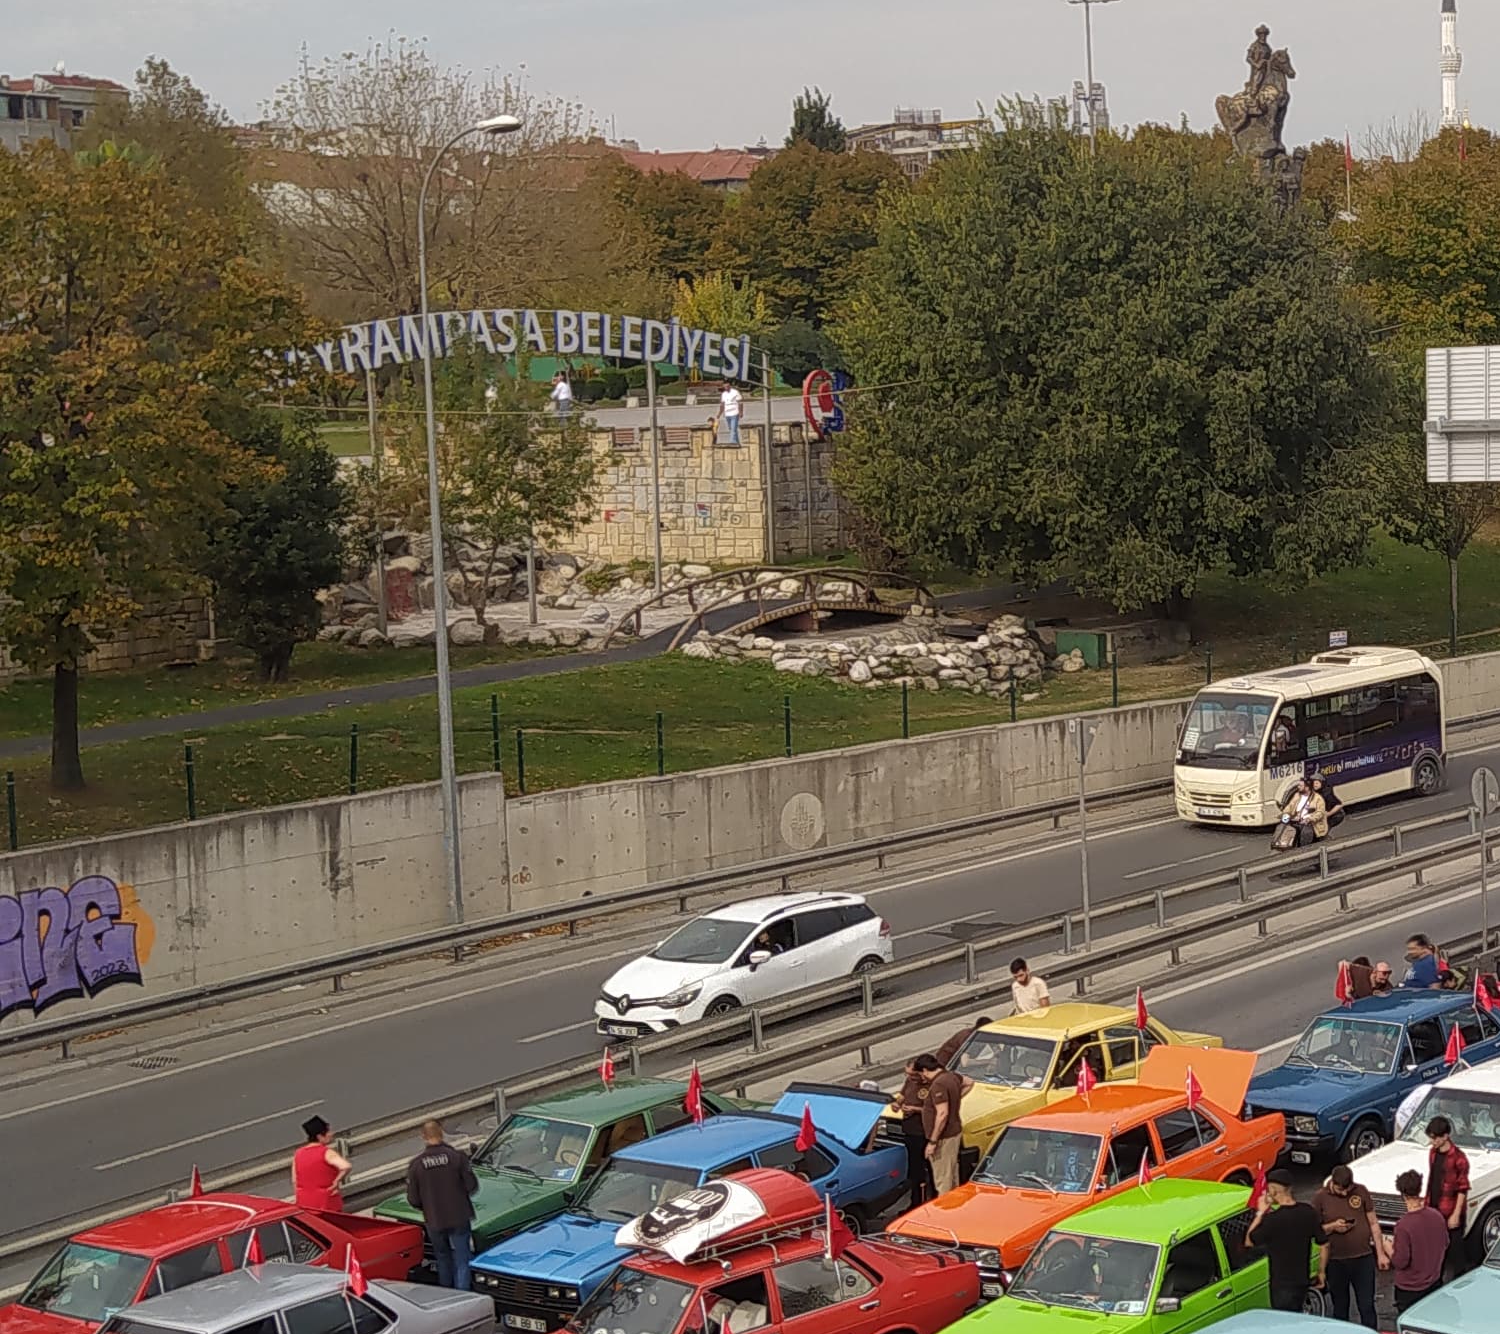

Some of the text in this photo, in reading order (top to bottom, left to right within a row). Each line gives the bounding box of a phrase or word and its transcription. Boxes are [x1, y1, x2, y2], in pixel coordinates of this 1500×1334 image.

[553, 309, 751, 383] BELEDİYESİ
[1270, 762, 1304, 781] M6216
[91, 959, 130, 982] 2023
